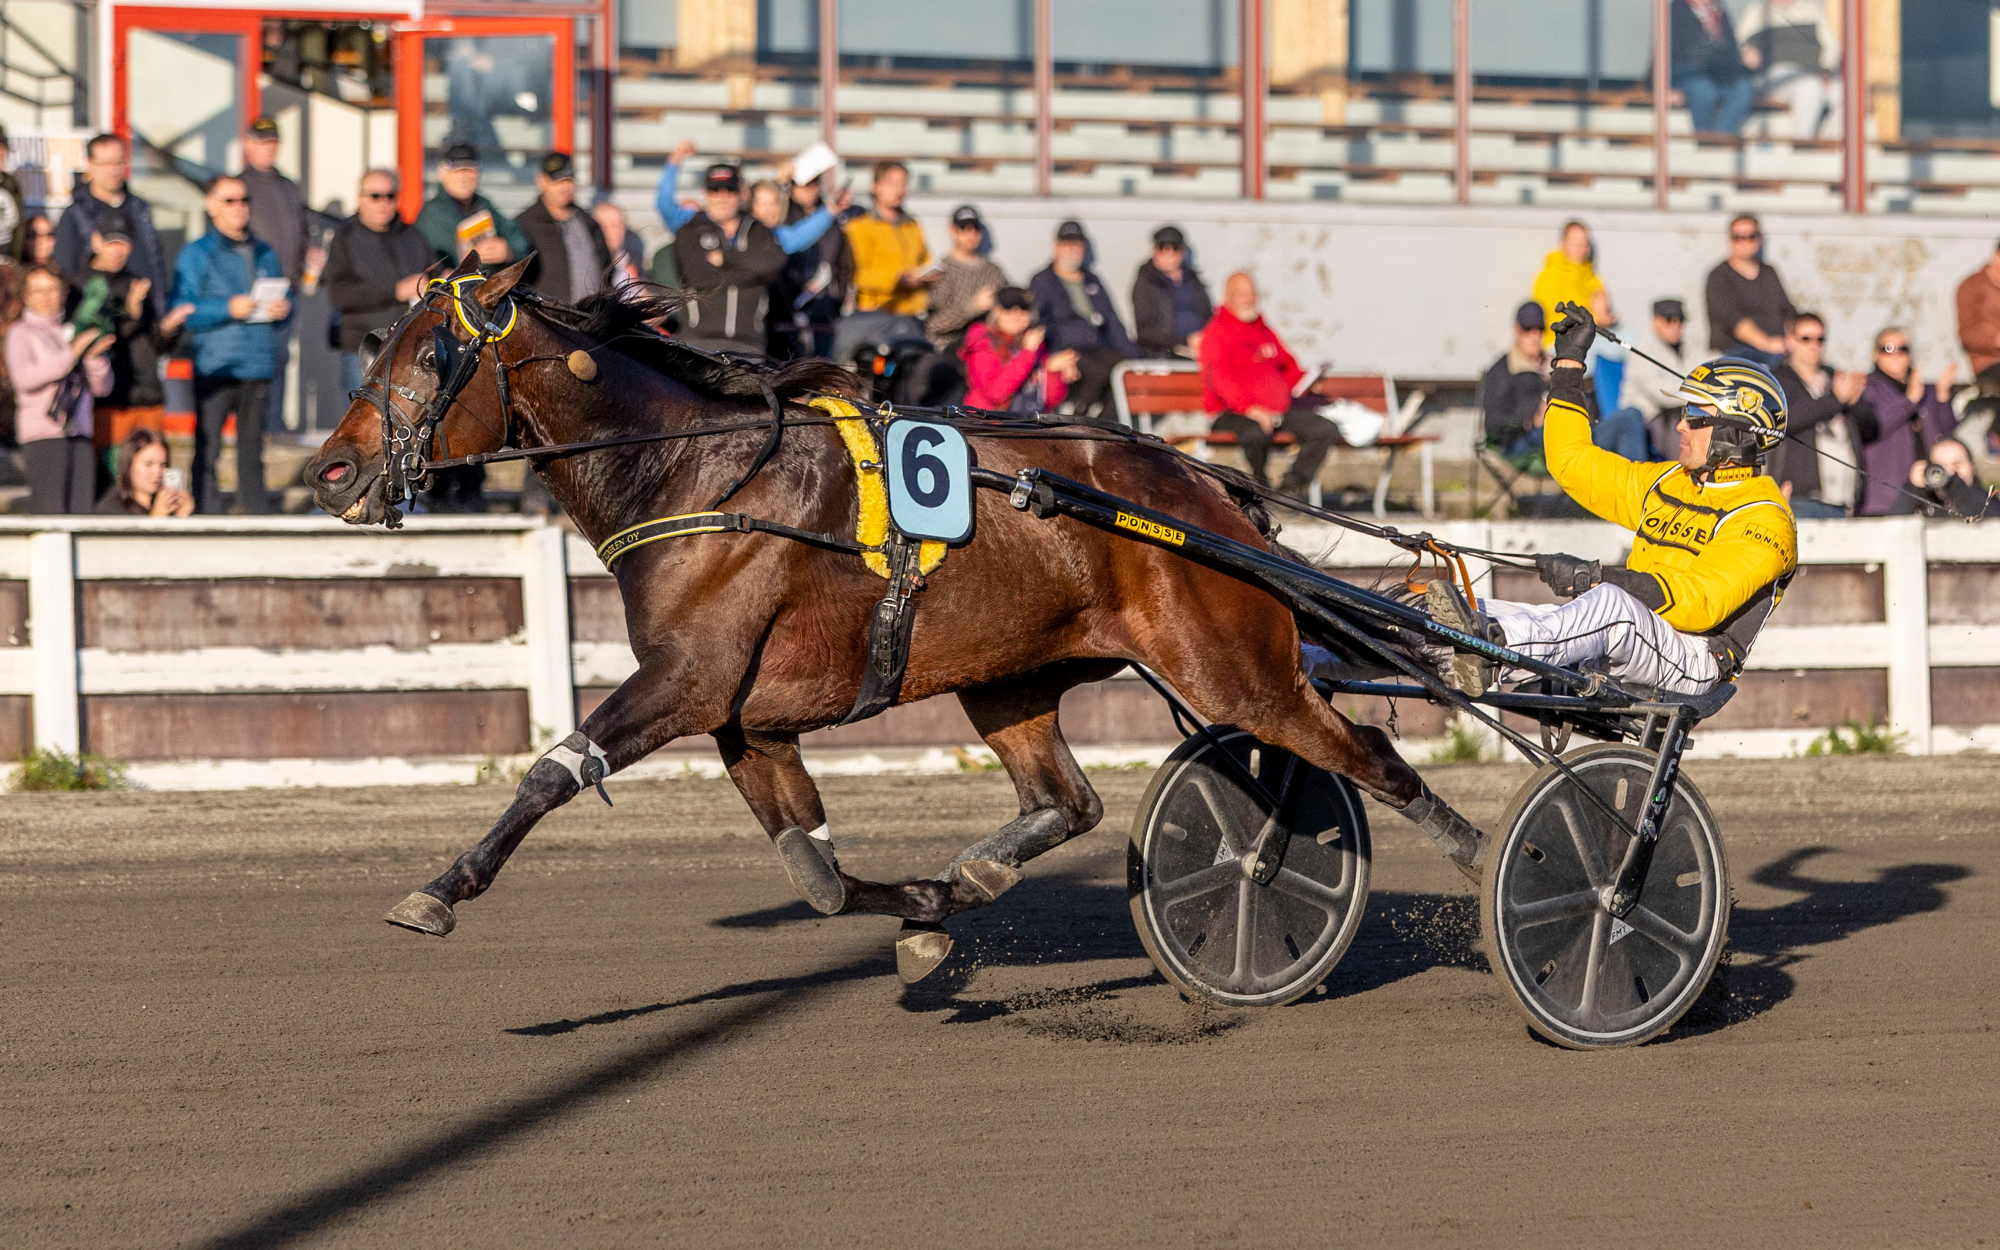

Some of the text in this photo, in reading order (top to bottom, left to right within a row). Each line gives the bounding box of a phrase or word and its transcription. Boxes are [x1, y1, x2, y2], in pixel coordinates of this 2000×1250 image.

[902, 426, 951, 508] 6
[627, 531, 640, 544] OY
[1118, 514, 1184, 542] PONSSE
[1745, 529, 1791, 565] PONSSE
[1611, 924, 1627, 941] FMT
